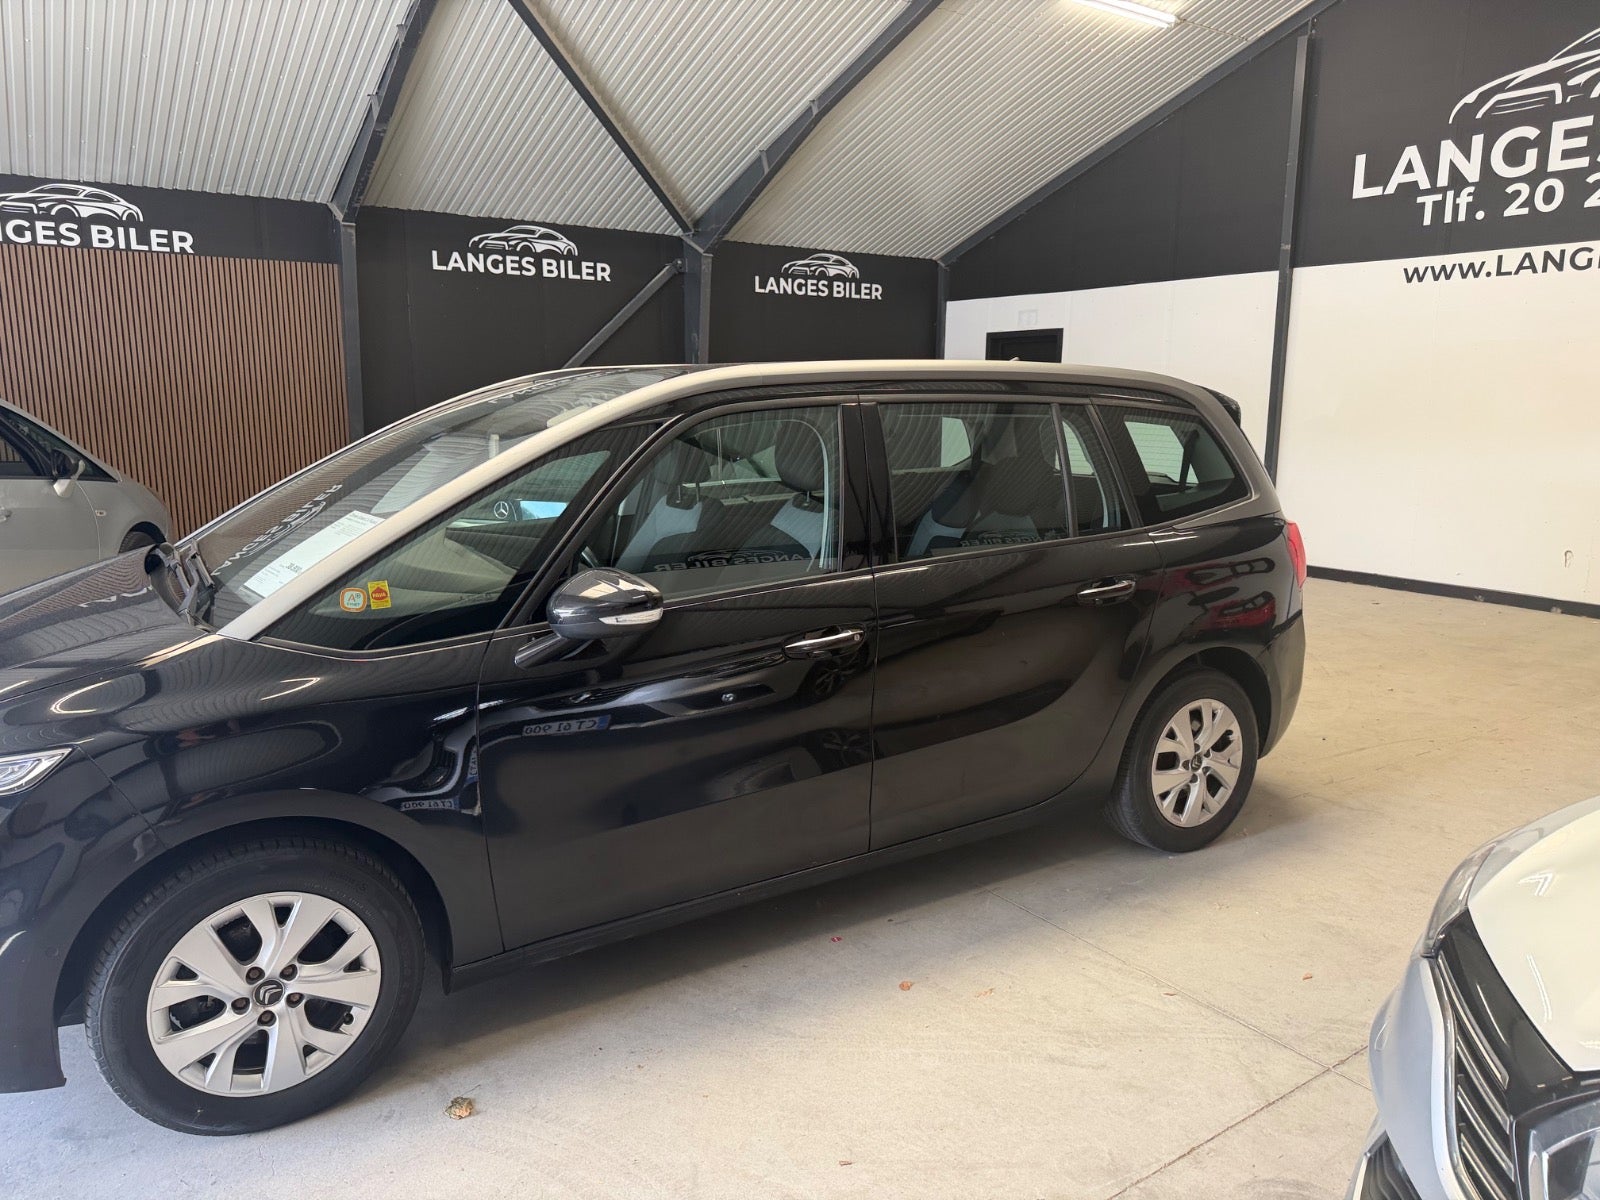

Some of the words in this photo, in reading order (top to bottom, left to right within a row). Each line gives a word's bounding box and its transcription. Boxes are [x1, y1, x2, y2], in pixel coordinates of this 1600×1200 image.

[1352, 115, 1600, 199] LANGE
[1416, 186, 1486, 226] Tlf.
[1503, 178, 1564, 217] 20
[0, 218, 81, 246] GES
[90, 224, 195, 254] BILER
[431, 250, 537, 277] LANGES
[541, 257, 612, 282] BILER
[1403, 247, 1600, 284] www.LANG
[754, 275, 829, 298] LANGES
[832, 281, 883, 300] BILER
